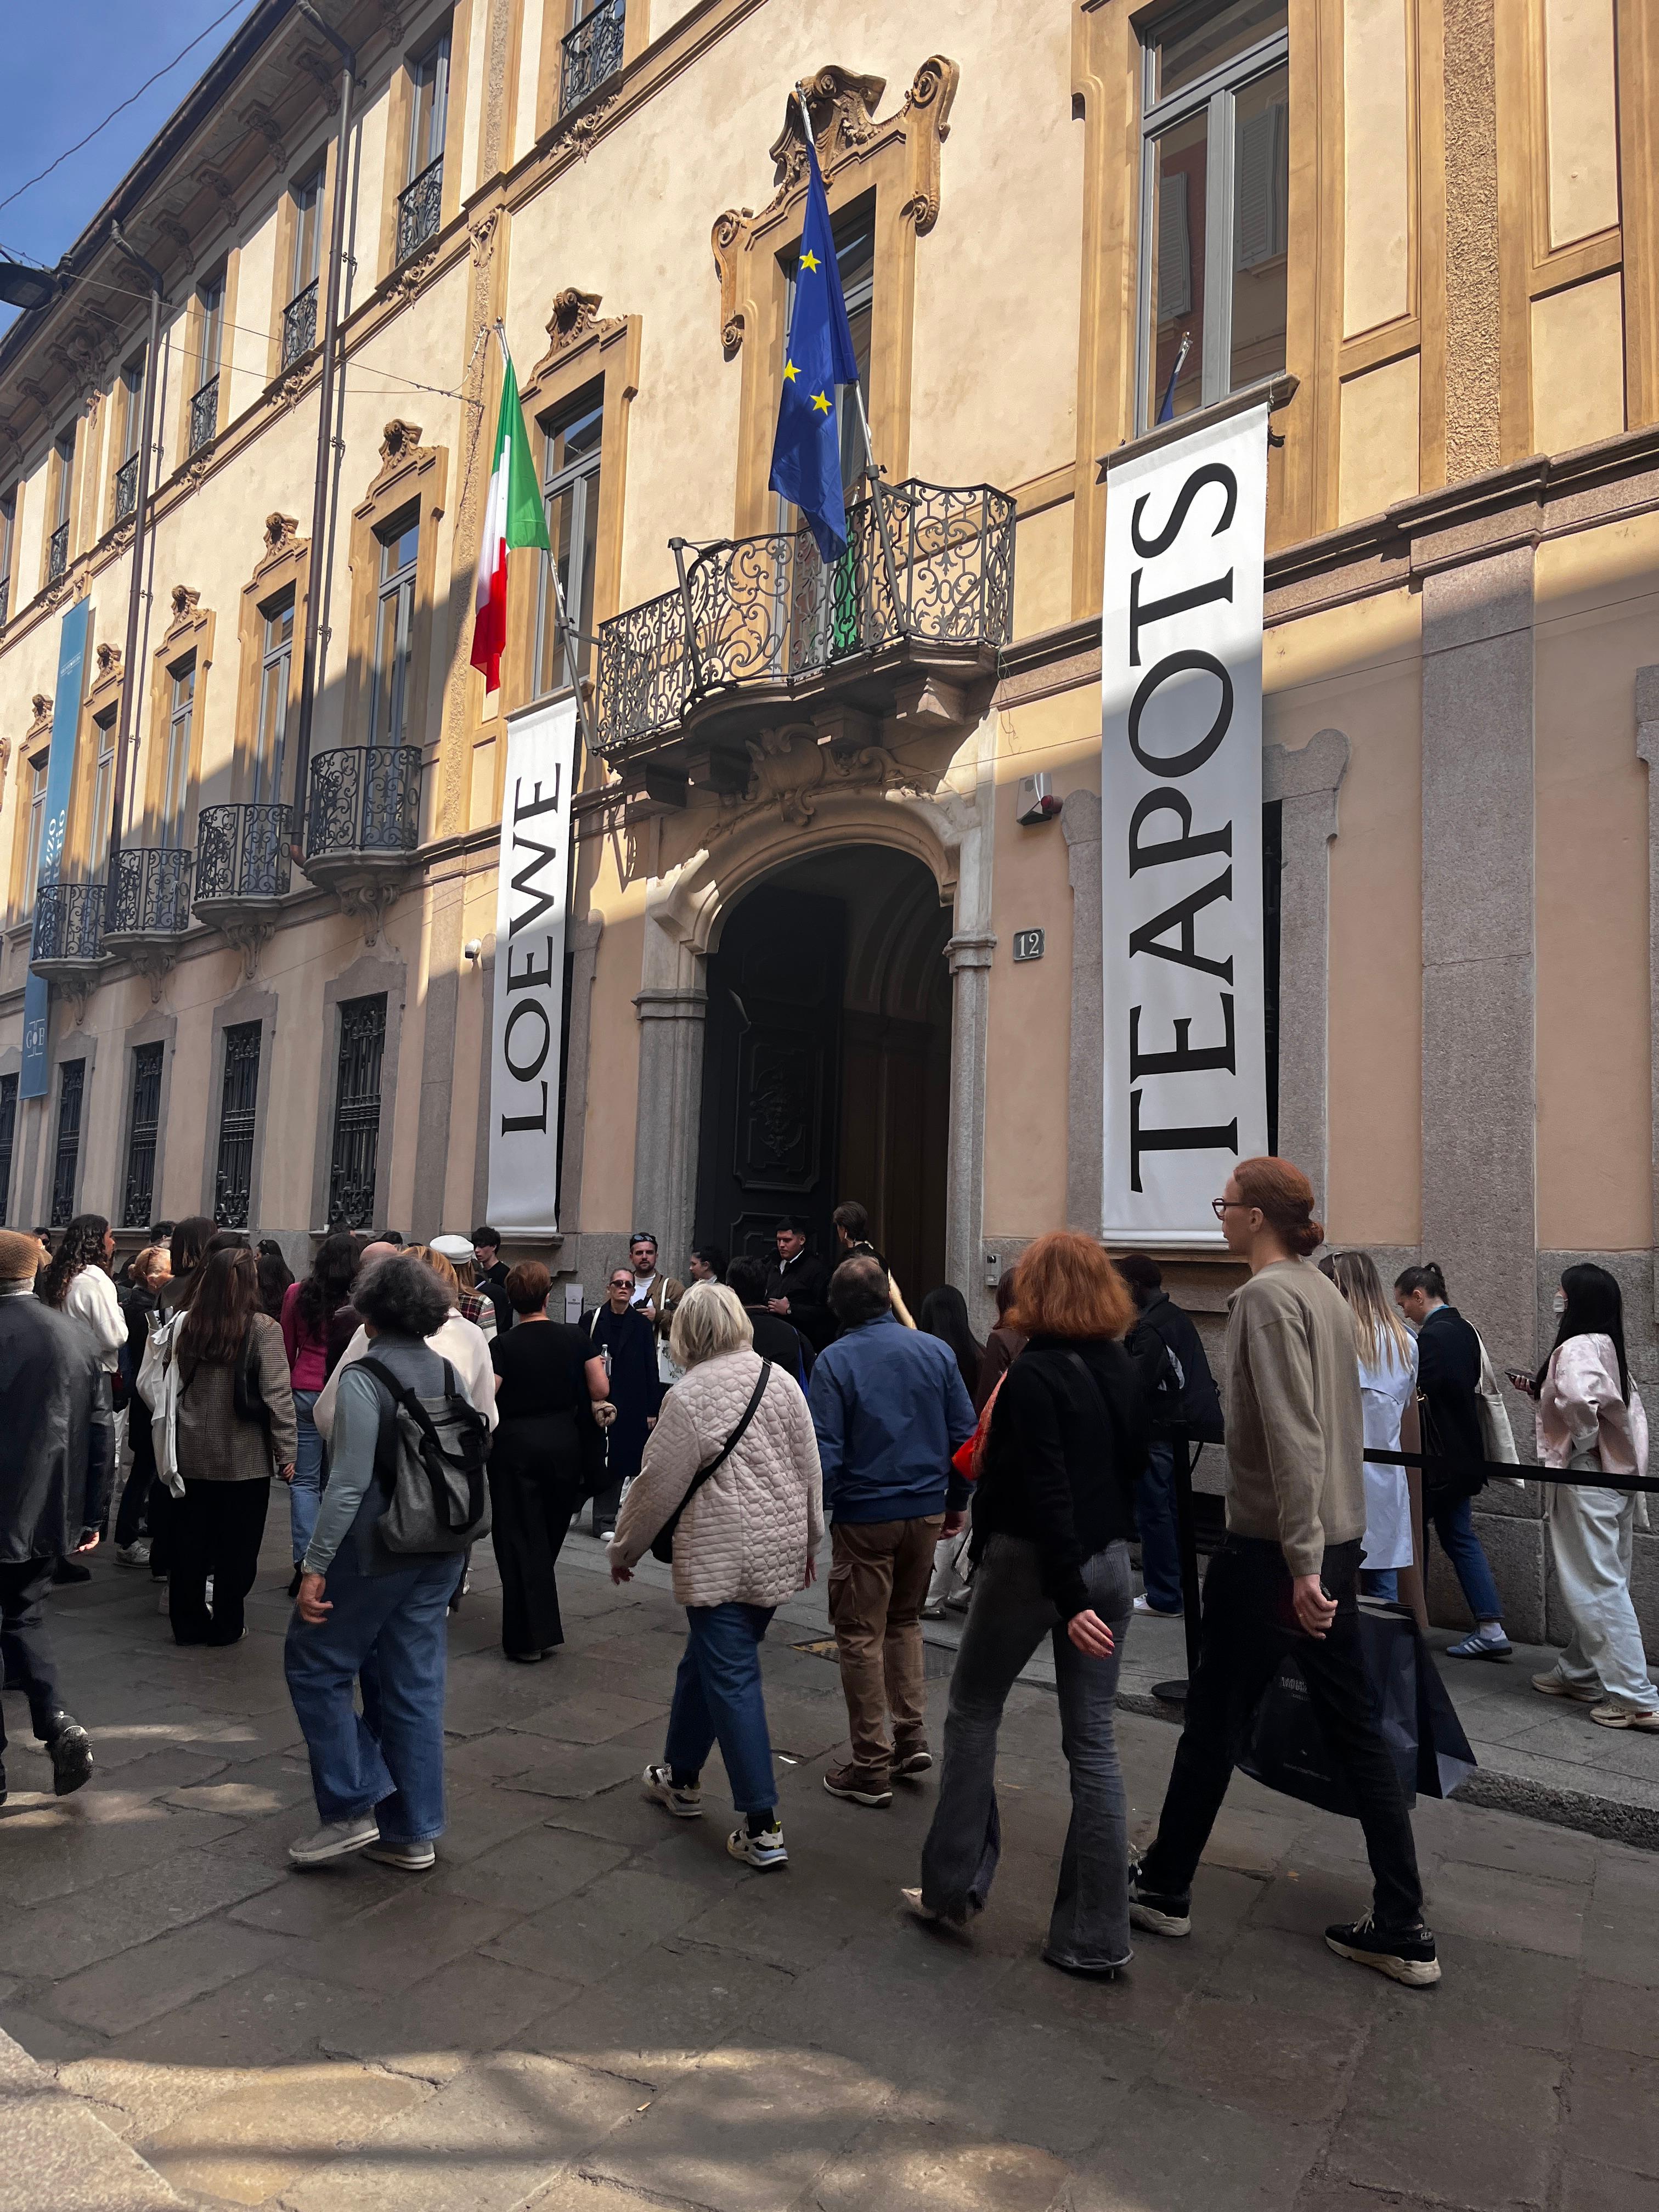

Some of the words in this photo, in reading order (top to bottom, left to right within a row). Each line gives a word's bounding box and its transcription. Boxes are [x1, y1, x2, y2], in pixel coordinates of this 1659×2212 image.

[501, 763, 561, 1137] LOEWE
[1019, 933, 1039, 957] 12
[1128, 463, 1238, 1193] TEAPOTS
